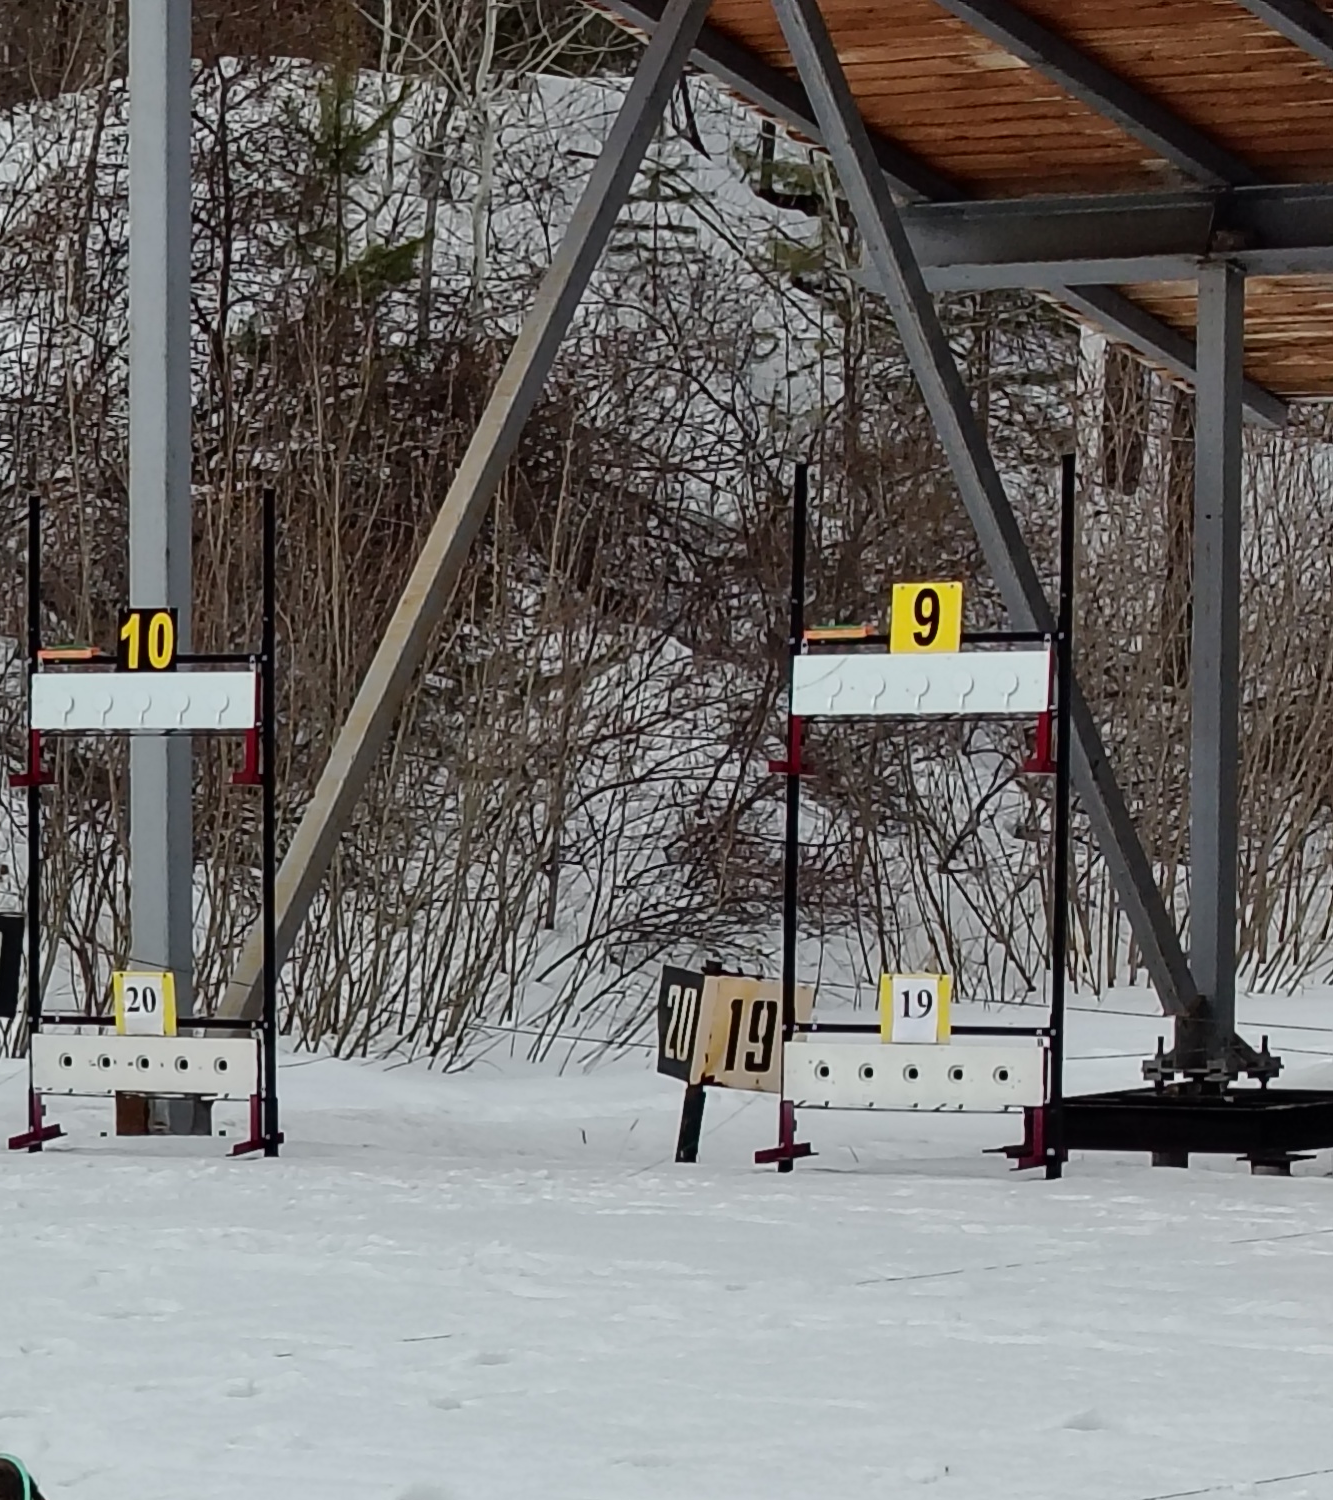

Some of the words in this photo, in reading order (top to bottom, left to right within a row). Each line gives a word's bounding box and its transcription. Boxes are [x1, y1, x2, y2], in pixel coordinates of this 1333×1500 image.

[120, 611, 174, 669] 10
[913, 588, 940, 646] 9
[126, 986, 157, 1013] 20
[664, 984, 698, 1062] 20
[901, 989, 933, 1019] 19
[724, 998, 778, 1073] 19
